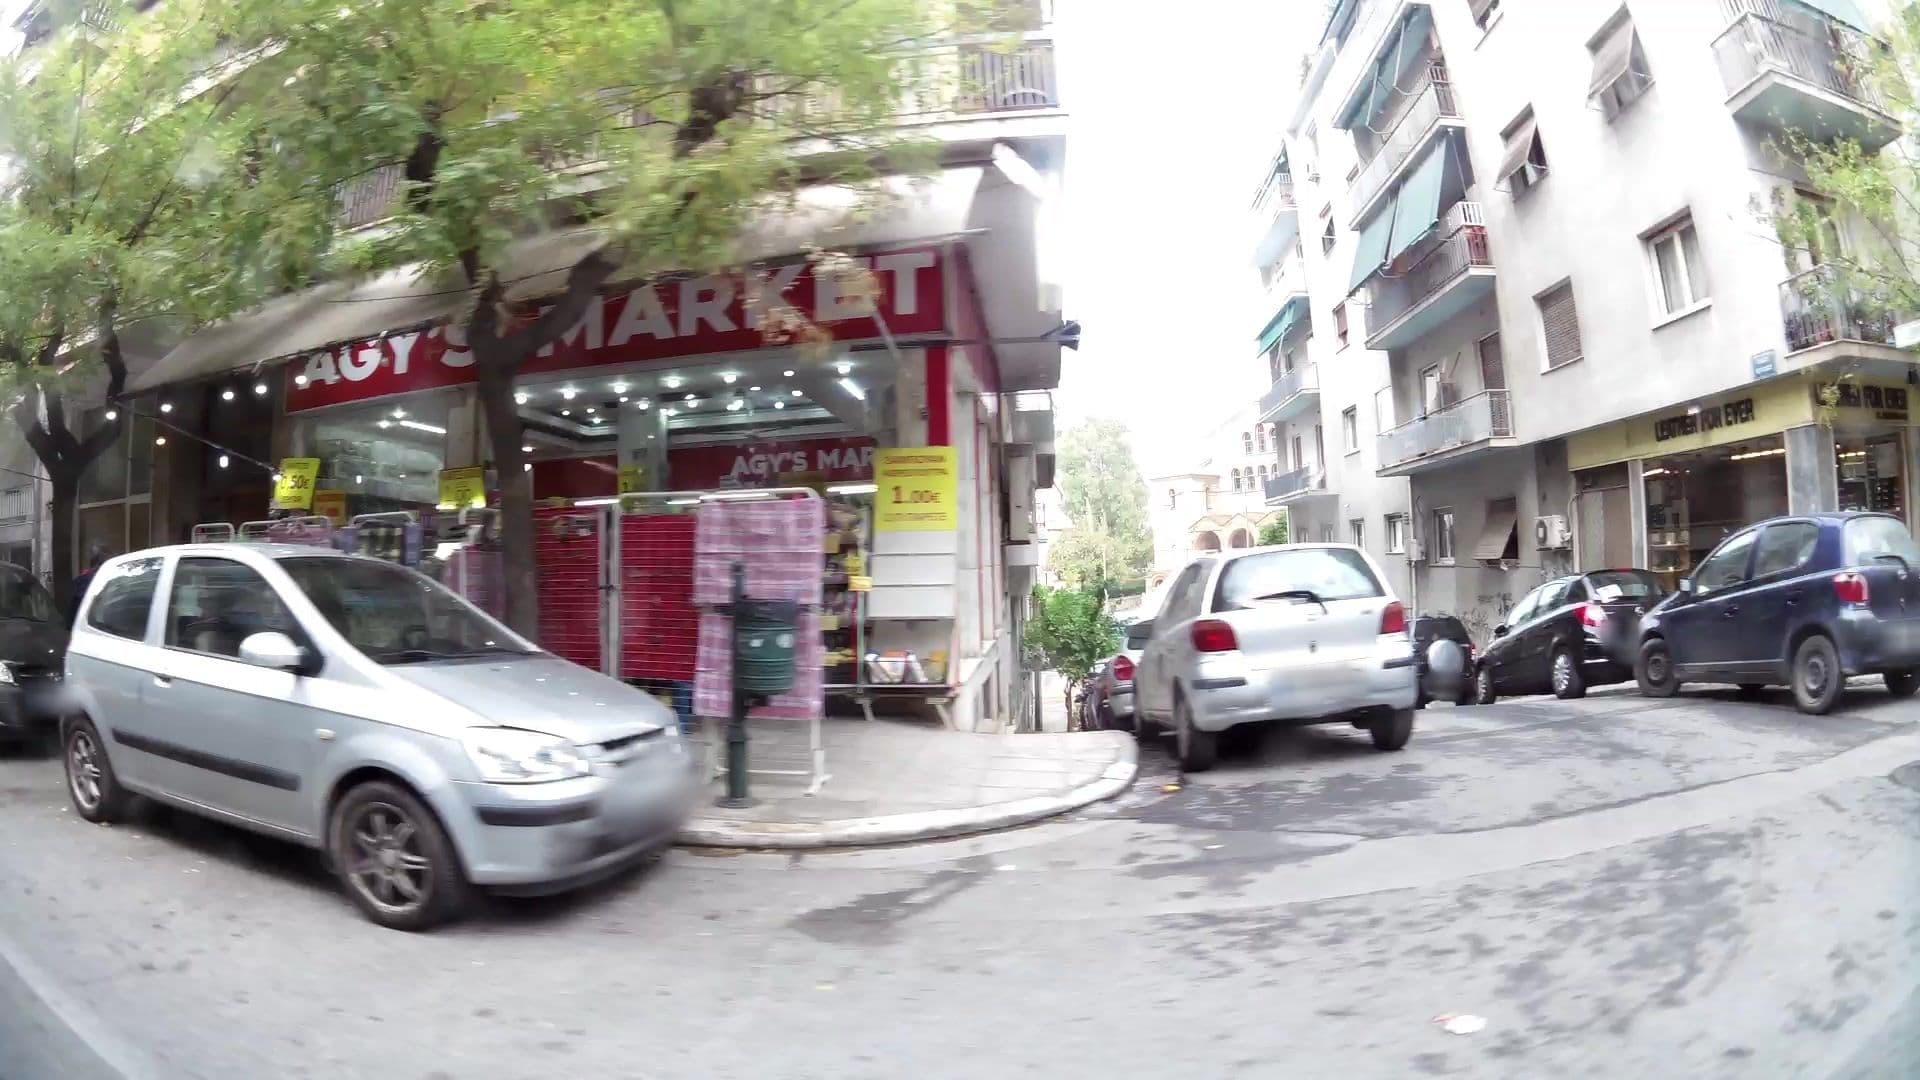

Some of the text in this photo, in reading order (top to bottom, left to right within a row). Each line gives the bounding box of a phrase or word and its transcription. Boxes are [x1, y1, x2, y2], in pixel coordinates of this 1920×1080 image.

[297, 251, 935, 390] AGY'S MARKET
[729, 452, 809, 479] AGY'S
